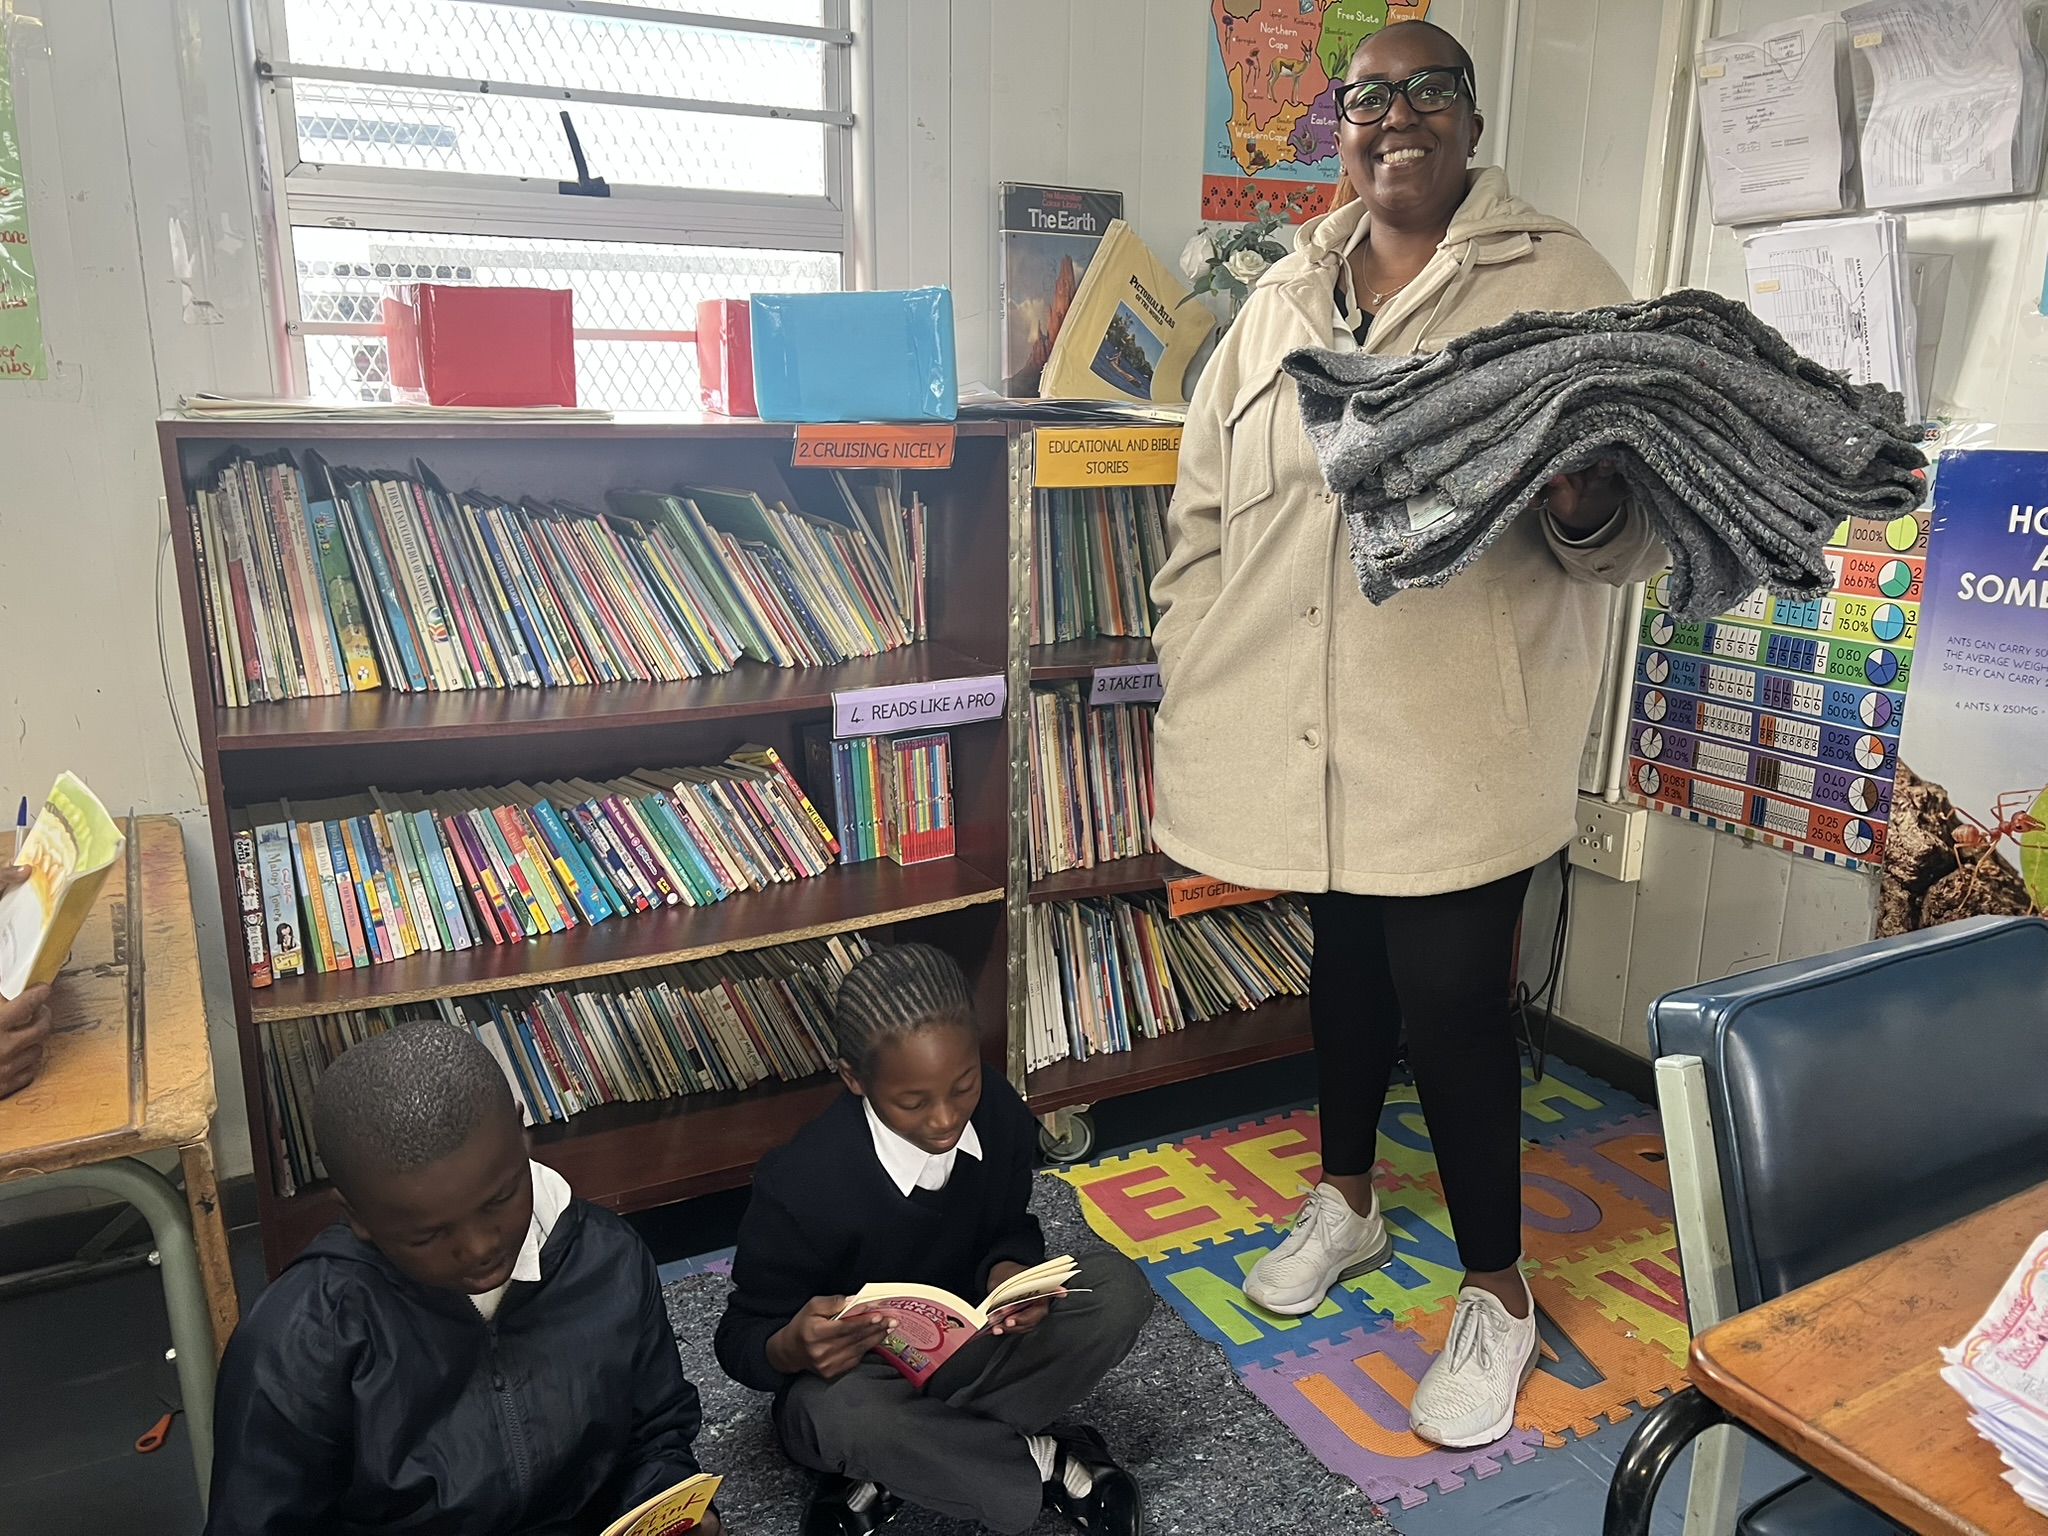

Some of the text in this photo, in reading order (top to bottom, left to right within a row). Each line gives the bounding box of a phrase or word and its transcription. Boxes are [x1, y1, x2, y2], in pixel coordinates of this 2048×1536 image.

[1337, 8, 1379, 24] Free State
[1260, 22, 1298, 37] Northern
[1269, 38, 1289, 54] Cape
[1235, 127, 1289, 145] Western Cape
[1028, 208, 1096, 232] The Earth
[893, 442, 947, 459] NICELY
[1048, 437, 1179, 454] EDUCATIONAL AND BIBLE
[1085, 461, 1129, 475] STORIES
[280, 473, 293, 502] THINGS
[314, 516, 332, 557] Stories
[1852, 528, 1883, 542] 100.0%
[385, 485, 435, 605] FIRST ENCYCLOPEDIA OF SCIENCE
[514, 533, 522, 543] THE
[518, 542, 530, 561] LITTLE
[494, 552, 512, 585] GLITTER'S
[507, 584, 521, 608] FLIGHT
[1845, 603, 1867, 617] 0.75
[1839, 617, 1870, 633] 75.0%
[1674, 633, 1700, 648] 20.0%
[1947, 636, 1972, 648] ANTS
[1974, 639, 1996, 650] CAN
[1999, 643, 2032, 656] CARRY
[1836, 647, 1861, 662] 0.80
[1946, 649, 1964, 660] THE
[1965, 653, 2011, 668] AVERAGE
[1672, 660, 1696, 673] 0.167
[1829, 662, 1864, 678] 80.0%
[1956, 664, 2042, 686] THEY CAN CARRY
[1142, 674, 1155, 689] IT
[1671, 673, 1697, 687] 16.7%
[850, 692, 996, 724] 4. READS LIKE A PRO
[1827, 705, 1858, 721] 50.0%
[1963, 701, 1990, 712] ANTS
[2003, 704, 2039, 716] 250MG
[1822, 745, 1854, 762] 25.0%
[1815, 787, 1848, 804] 40.0%
[1817, 814, 1839, 829] 0.25
[496, 810, 521, 851] Roald Dahl
[1811, 827, 1841, 845] 25.0%
[312, 825, 330, 871] Roald Dahl
[328, 824, 346, 870] Roald Dahl
[262, 852, 287, 922] Malory Towers
[1179, 886, 1206, 902] JUST
[325, 887, 340, 931] GOING SOLO
[344, 897, 356, 927] WITCHES
